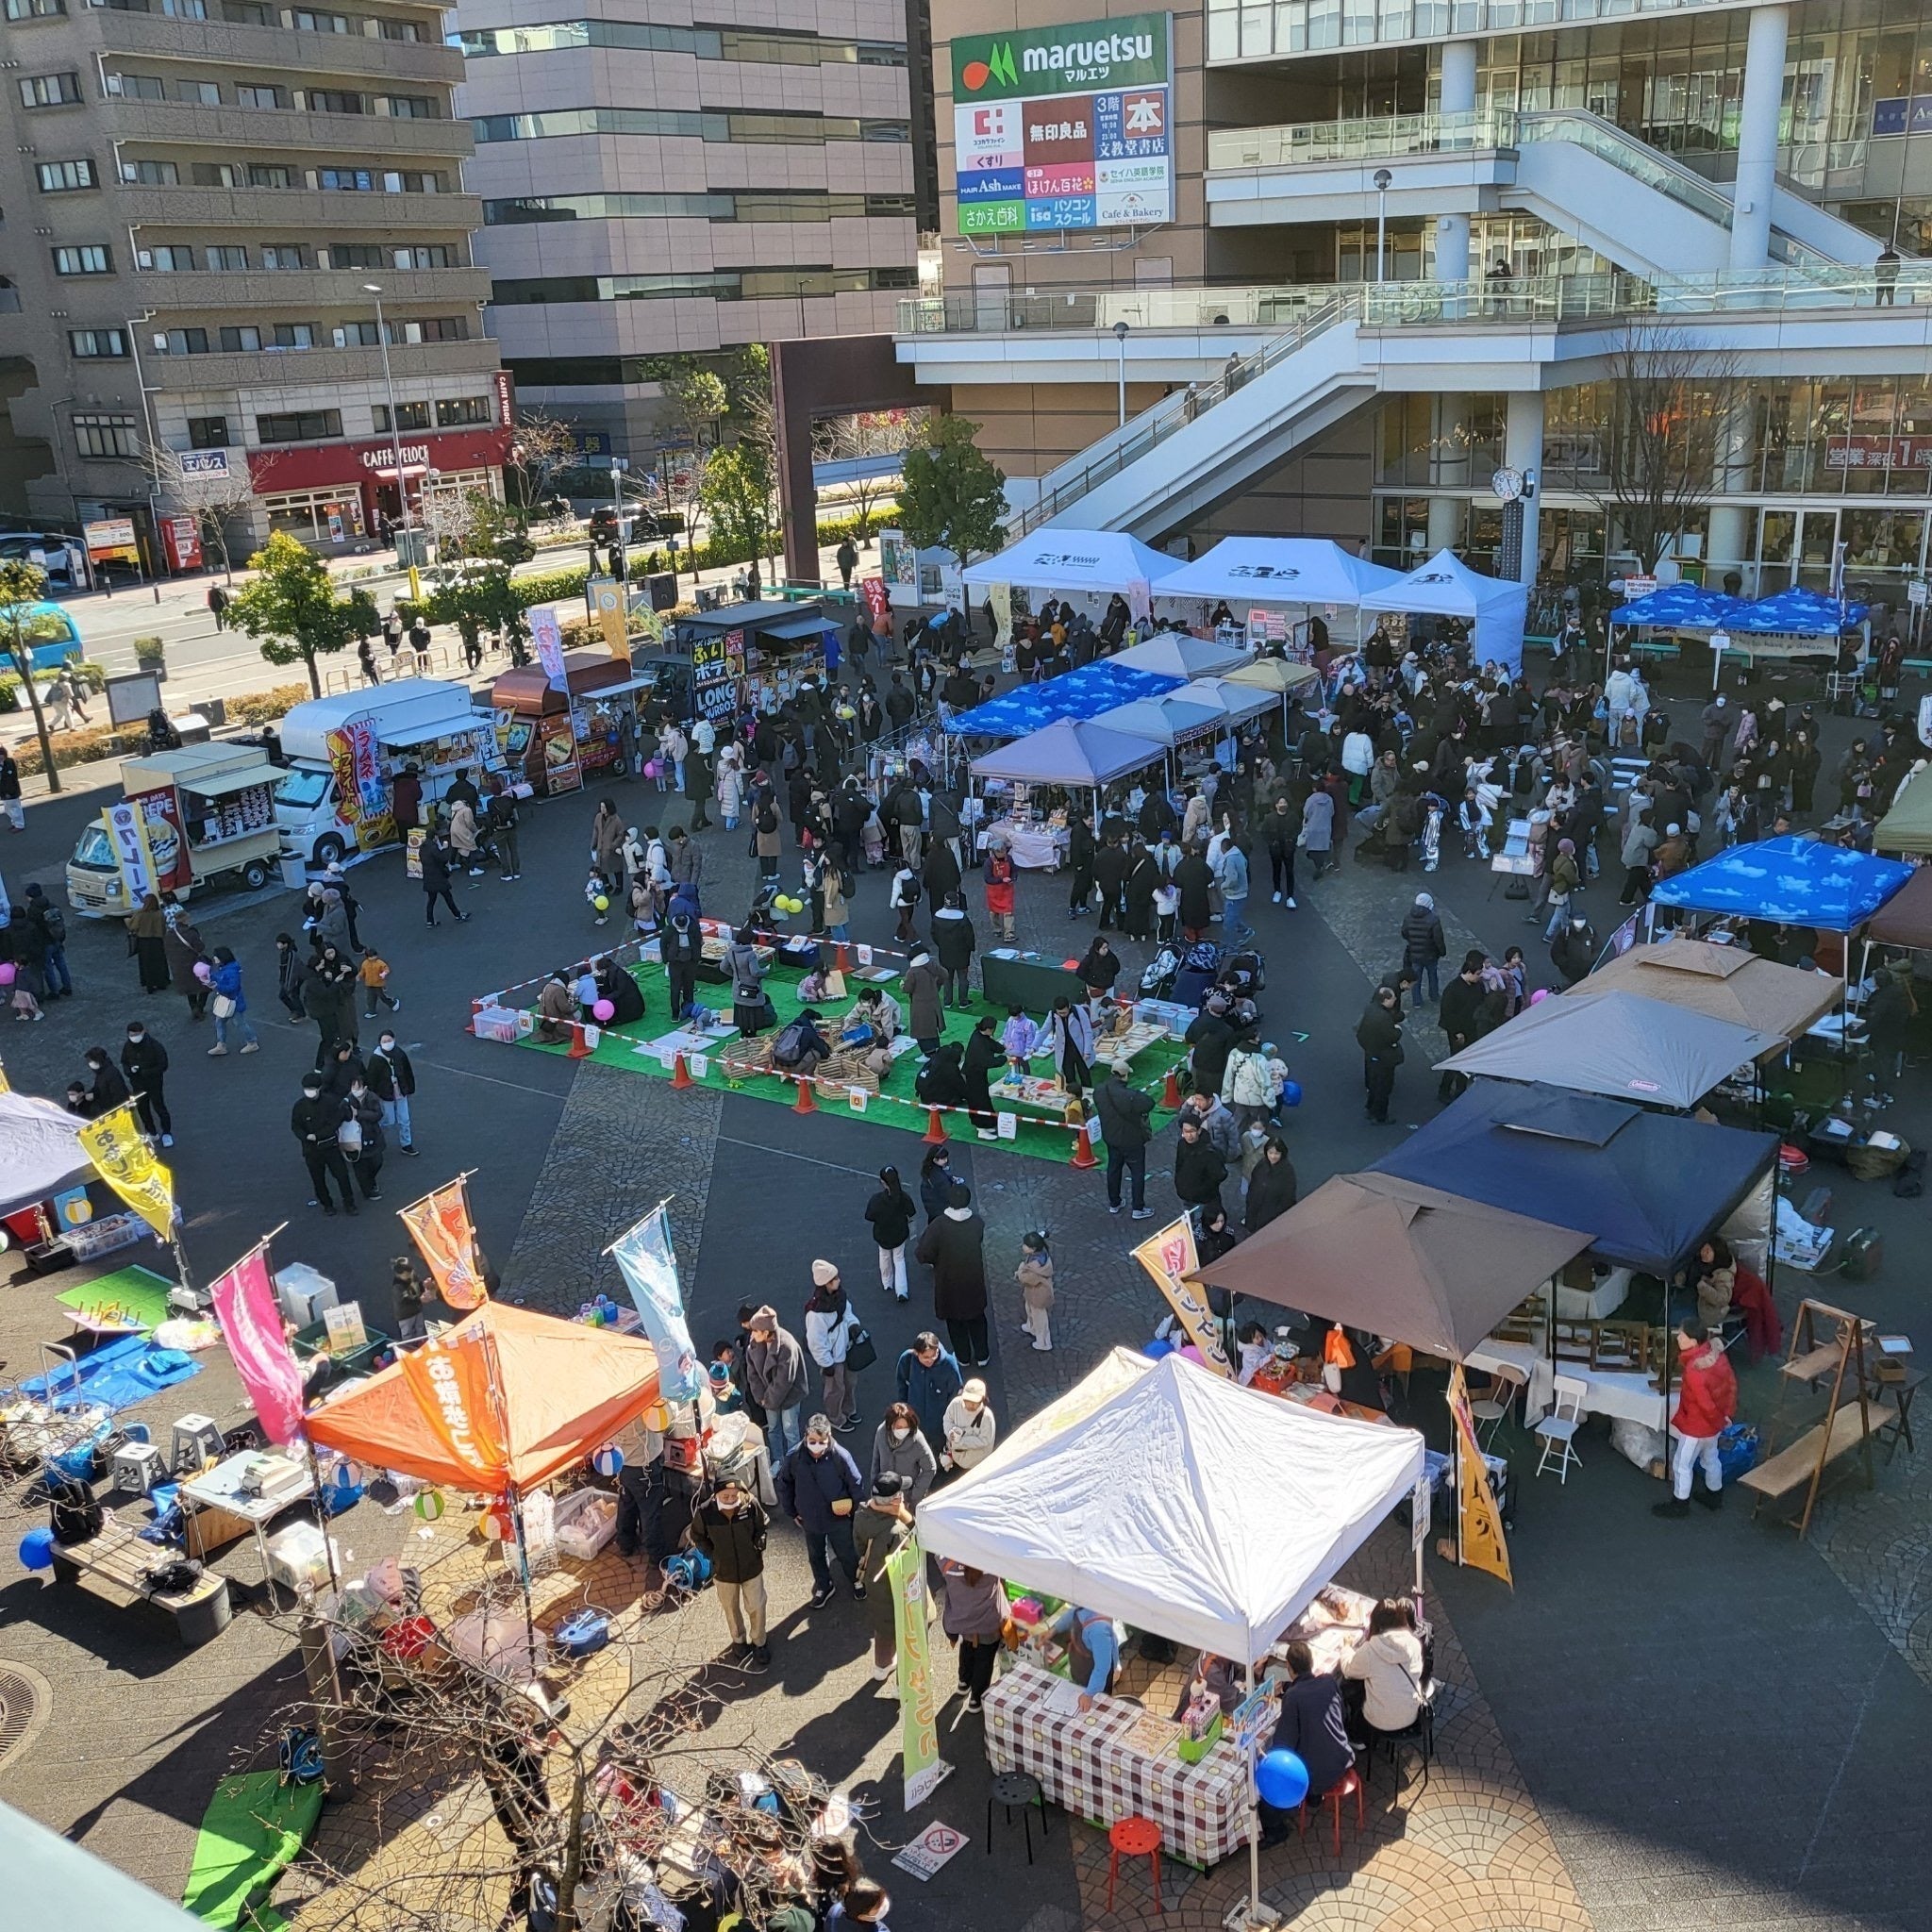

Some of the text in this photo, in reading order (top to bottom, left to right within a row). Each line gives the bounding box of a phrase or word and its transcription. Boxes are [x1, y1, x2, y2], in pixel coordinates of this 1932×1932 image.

[1023, 33, 1153, 73] maruetsu
[1065, 66, 1109, 83] マルエツ
[1097, 96, 1120, 112] 3階
[1126, 98, 1162, 132] 本
[1029, 121, 1088, 142] 無印良品
[973, 138, 1006, 146] ココカラファイン
[1098, 138, 1165, 158] 文教堂書店
[977, 155, 1003, 168] くすり
[1110, 165, 1165, 178] セイハ英語学院
[978, 178, 1003, 192] Ash
[1002, 183, 1022, 192] MAKE
[1027, 176, 1083, 194] ほけん百花
[1055, 198, 1091, 212] パソコン
[1133, 208, 1164, 218] Bakery
[966, 206, 1019, 227] さかえ歯科
[1055, 212, 1091, 225] スクール
[696, 680, 737, 712] LONG
[358, 729, 375, 781] ラムネ
